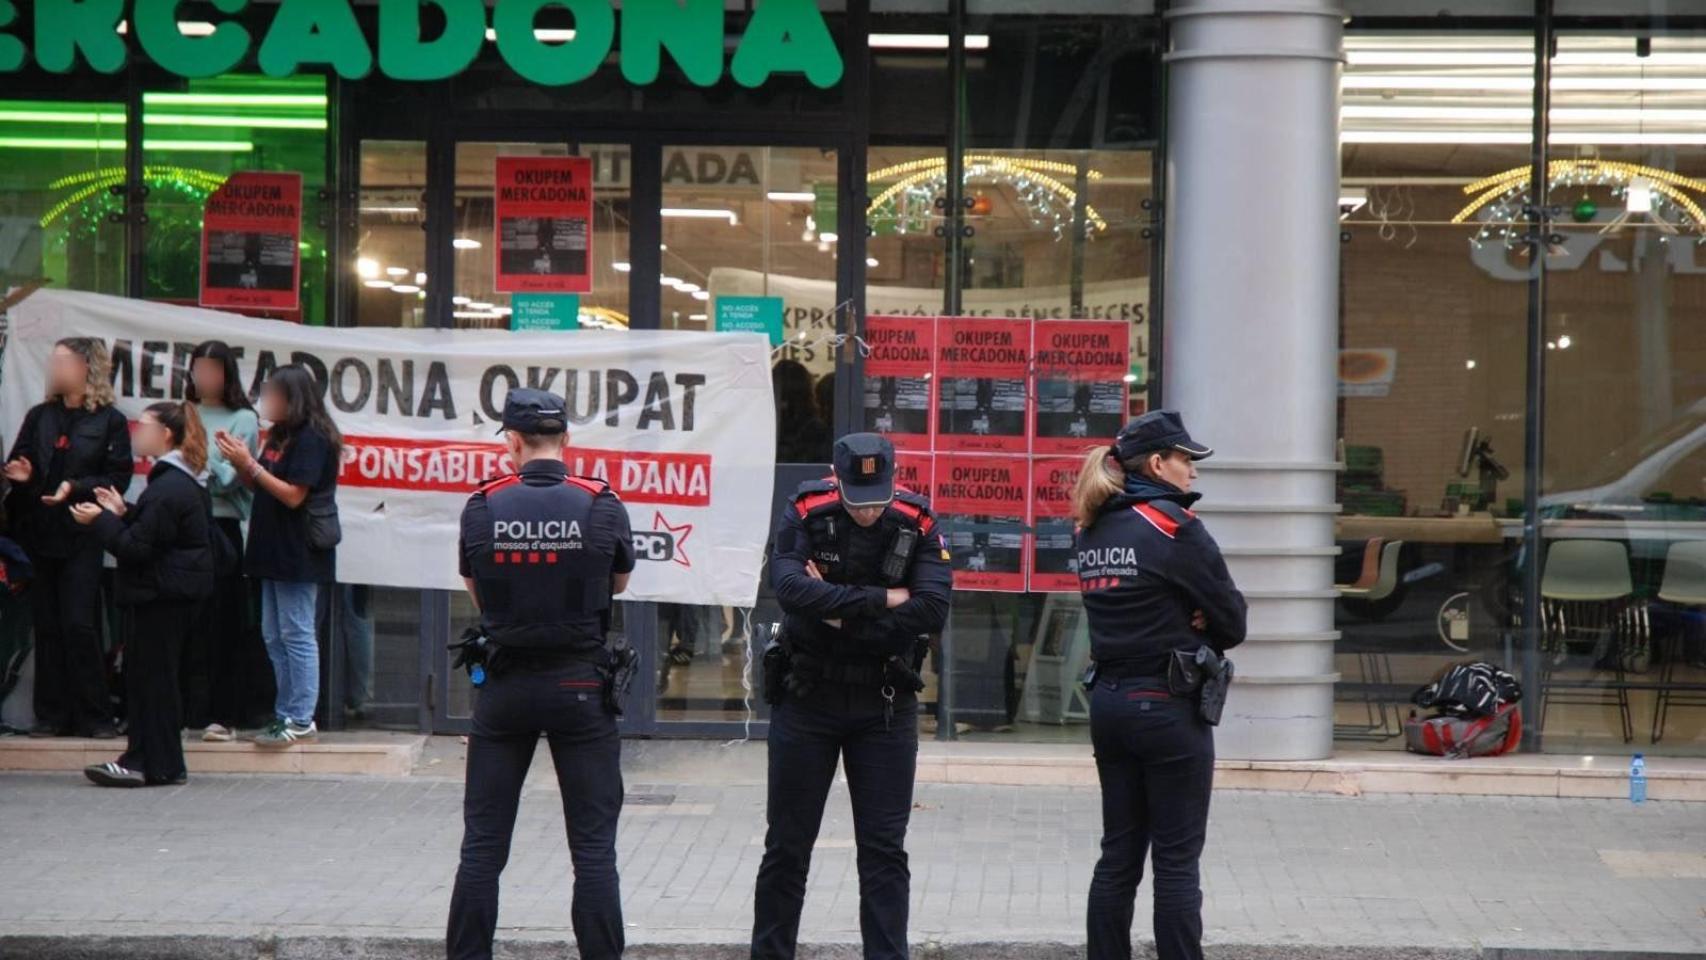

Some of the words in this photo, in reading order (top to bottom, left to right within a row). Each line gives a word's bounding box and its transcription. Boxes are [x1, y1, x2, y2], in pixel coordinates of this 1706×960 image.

[514, 170, 572, 185] OKUPEM
[225, 184, 282, 200] OKUPEM
[500, 187, 586, 201] MERCADONA
[207, 200, 296, 218] MERCADONA
[954, 330, 1013, 346] OKUPEM
[1052, 334, 1110, 349] OKUPEM
[940, 347, 1027, 363] MERCADONA
[1037, 350, 1124, 366] MERCADONA
[620, 459, 707, 496] DANA
[952, 467, 1011, 484] OKUPEM
[937, 484, 1023, 501] MERCADONA
[494, 520, 582, 539] POLICIA
[494, 542, 529, 550] mossos
[531, 540, 583, 552] d'esquadra
[1078, 547, 1137, 568] POLICIA
